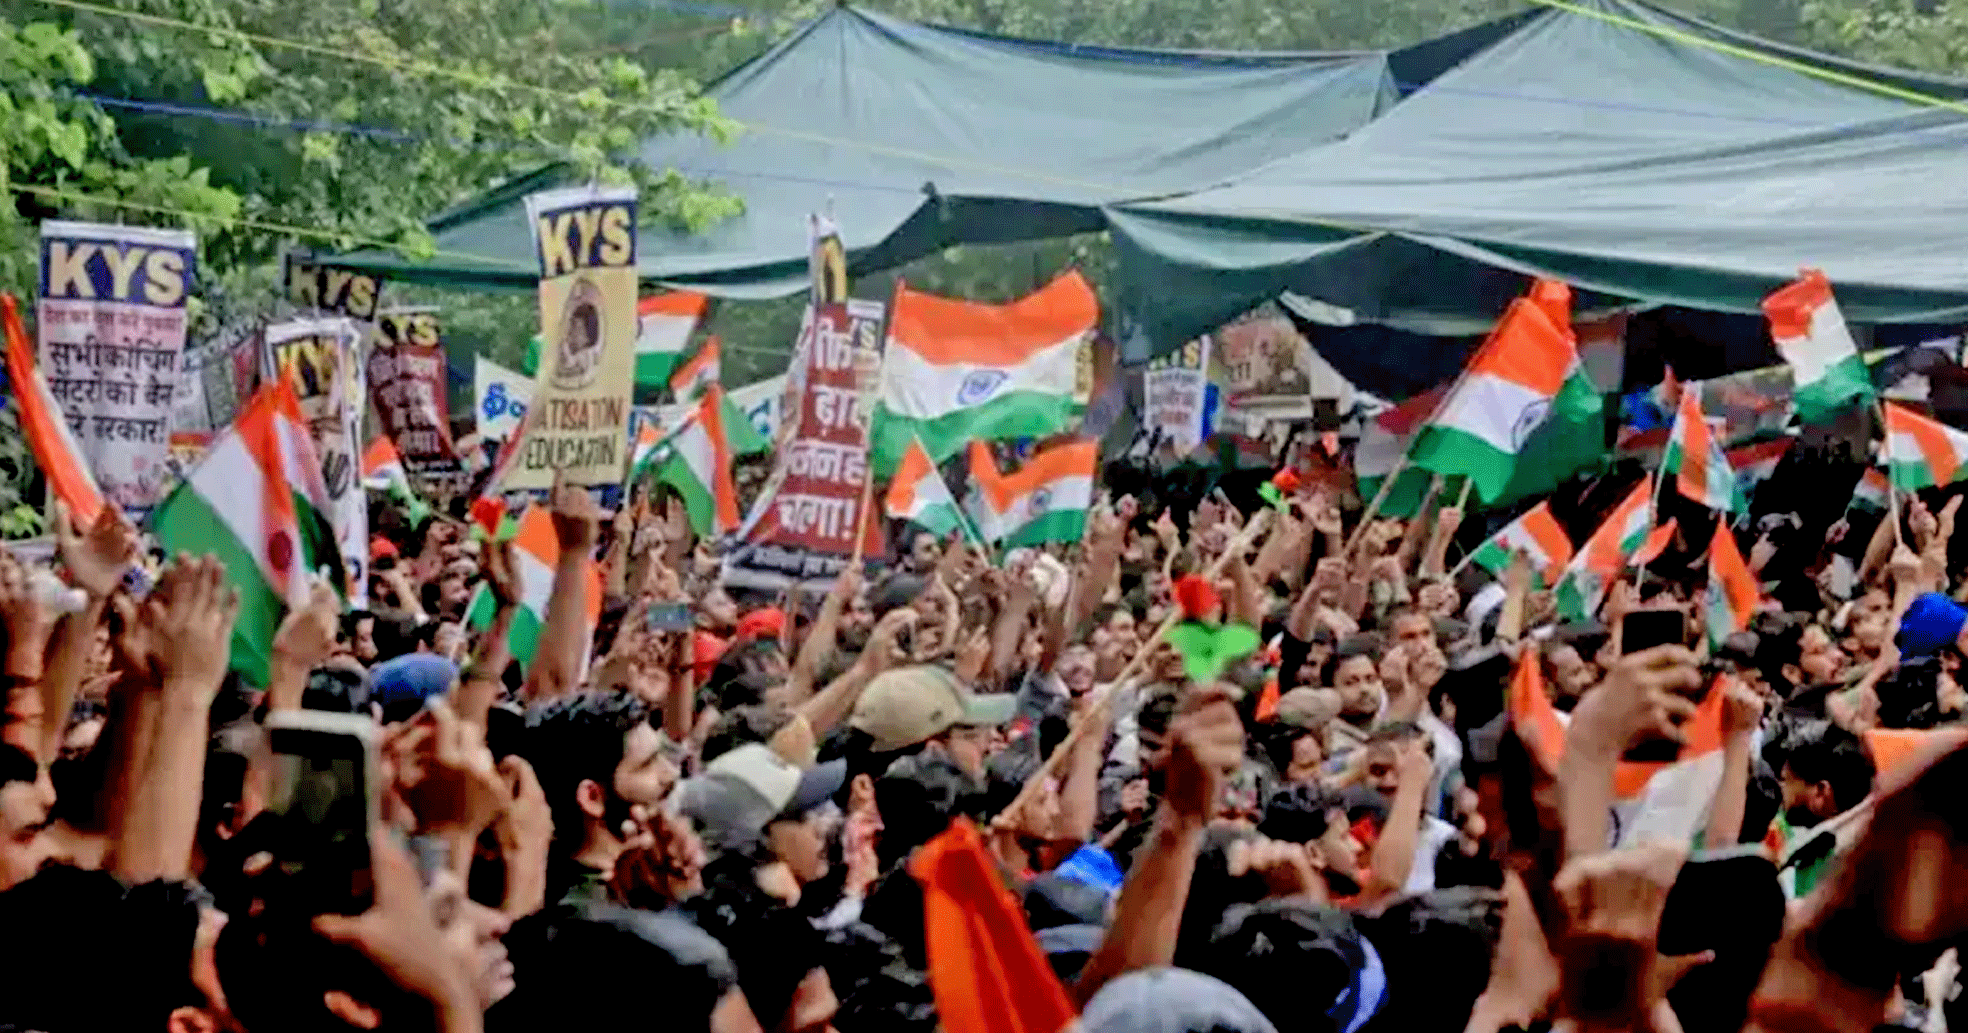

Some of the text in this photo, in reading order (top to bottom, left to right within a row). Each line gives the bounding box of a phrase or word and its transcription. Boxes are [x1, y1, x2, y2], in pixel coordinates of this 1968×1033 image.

[50, 241, 184, 305] KYS
[539, 205, 631, 279] KYS
[290, 264, 376, 318] KYS
